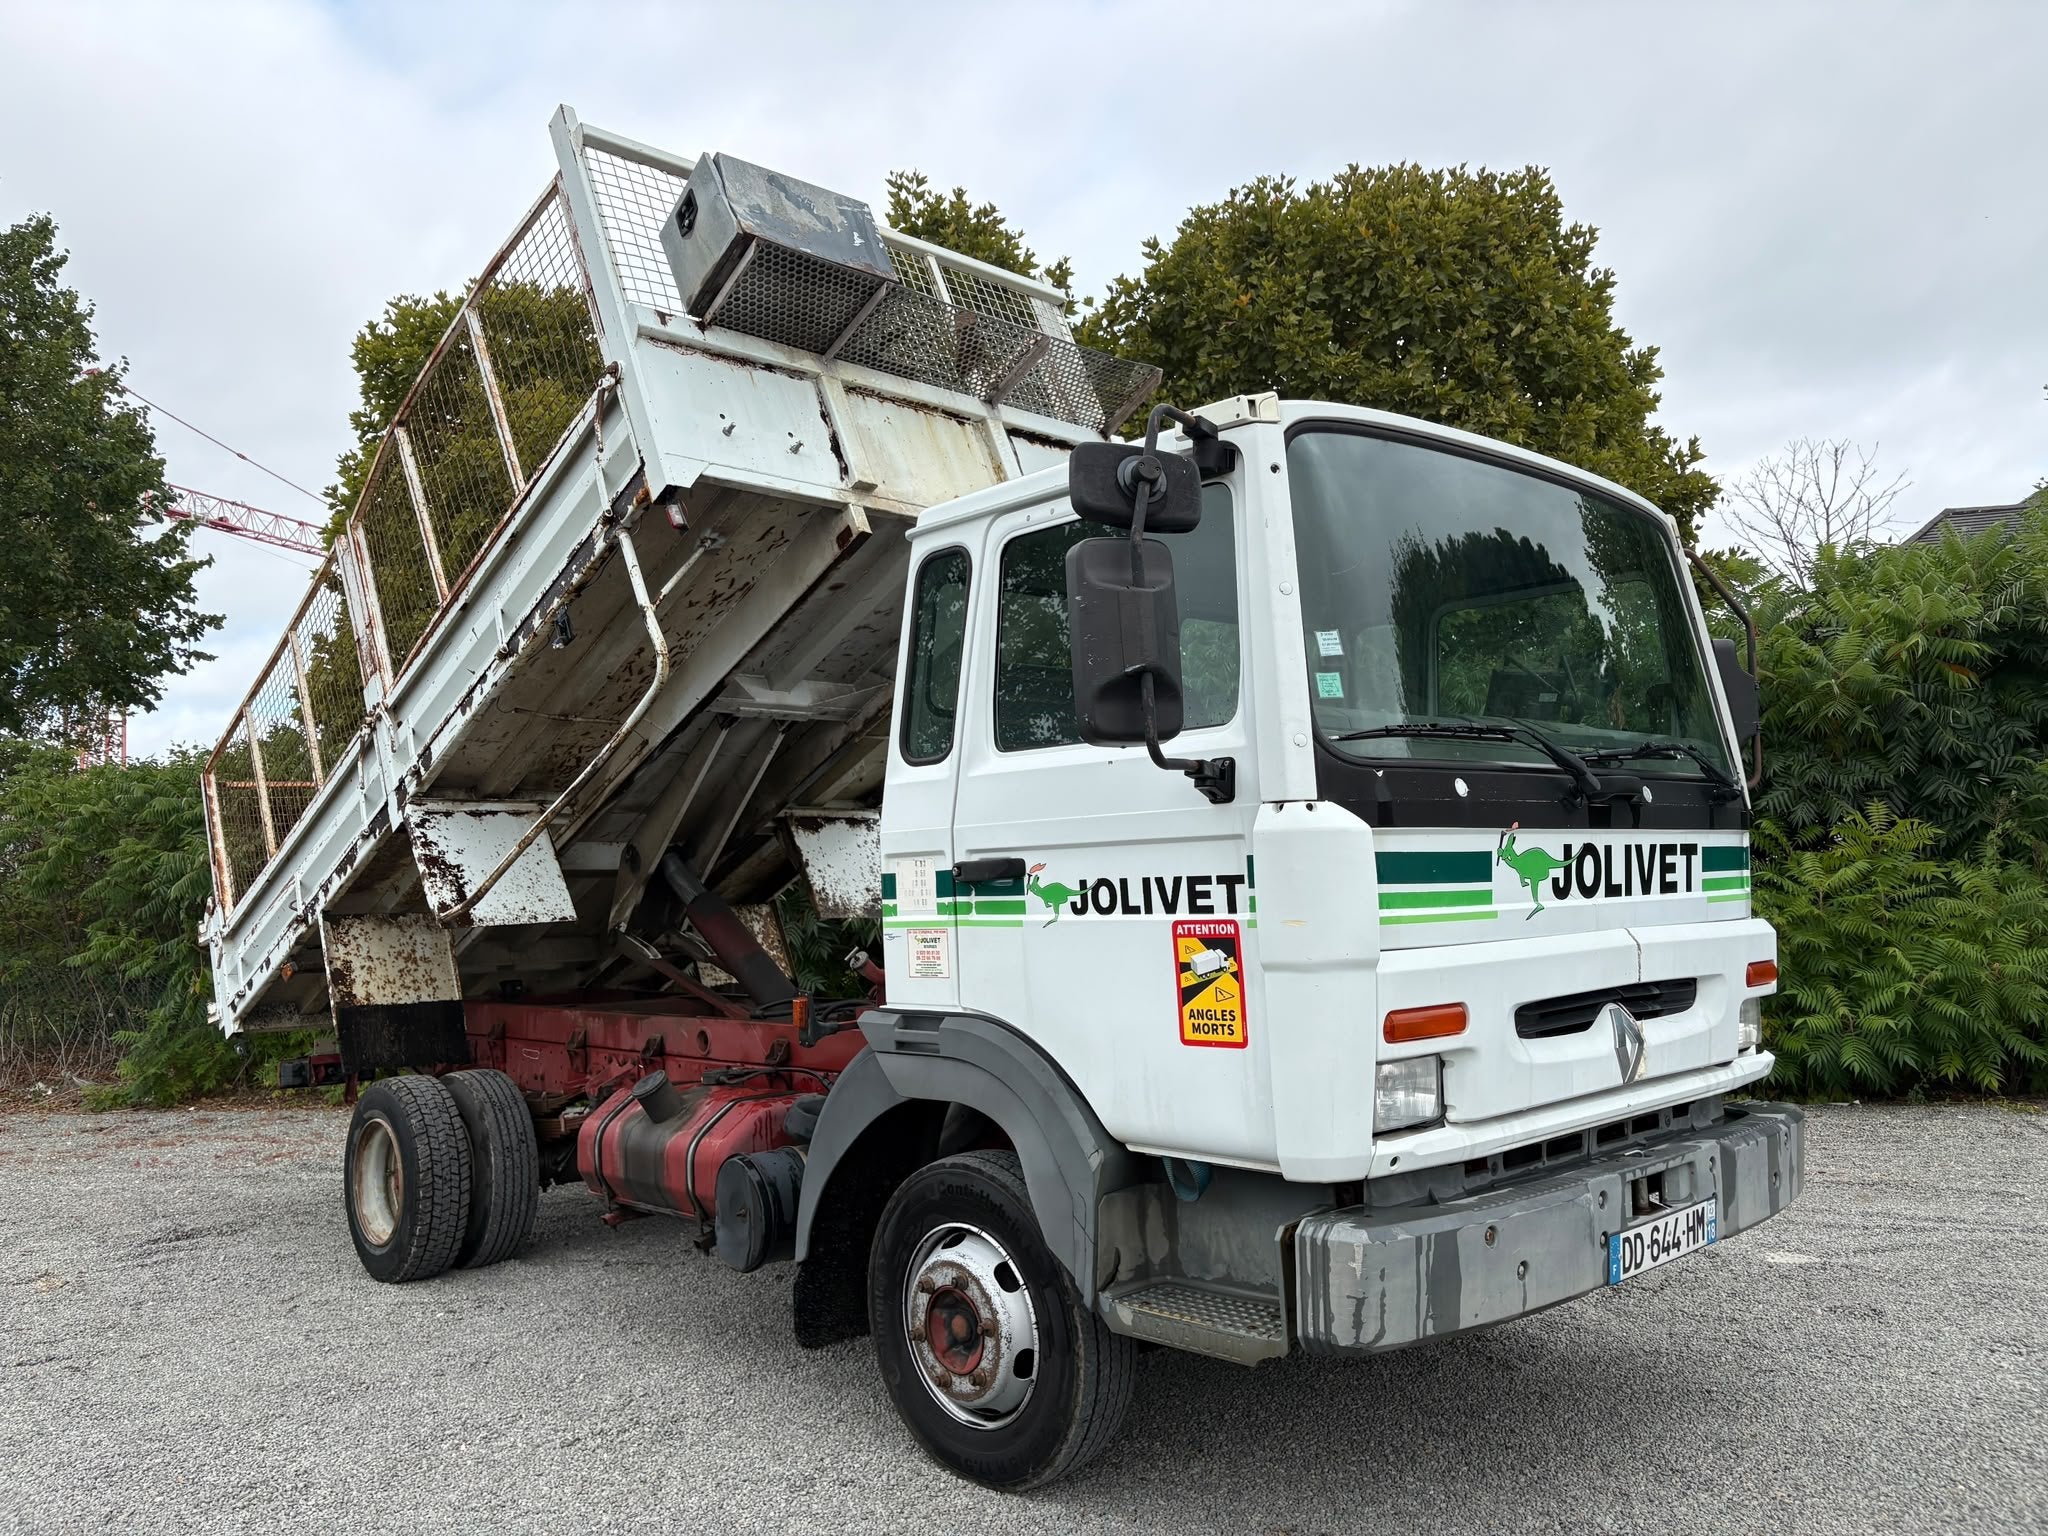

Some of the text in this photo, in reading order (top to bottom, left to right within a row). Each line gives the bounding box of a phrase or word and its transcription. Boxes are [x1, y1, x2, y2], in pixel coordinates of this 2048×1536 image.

[1551, 843, 1698, 900] JOLIVET
[1071, 875, 1245, 915] JOLIVET
[1176, 923, 1235, 935] ATTENTION
[1188, 1008, 1236, 1022] ANGLES
[1192, 1023, 1235, 1036] MORTS
[1707, 1223, 1716, 1240] 18
[1622, 1206, 1706, 1275] DD-644-HM
